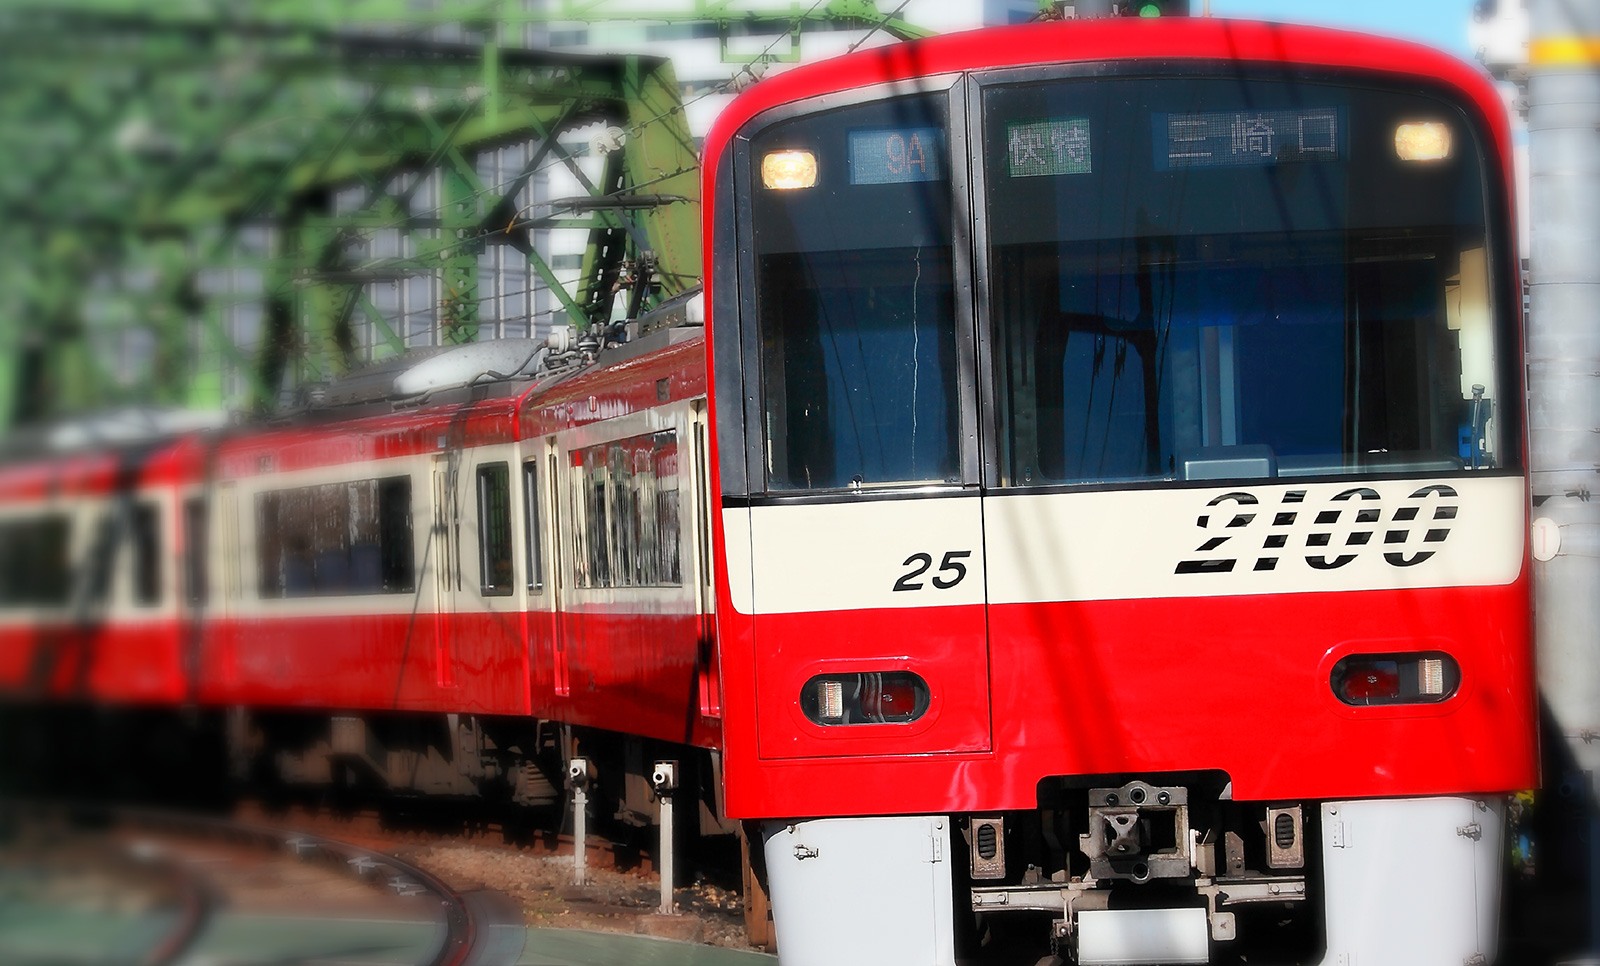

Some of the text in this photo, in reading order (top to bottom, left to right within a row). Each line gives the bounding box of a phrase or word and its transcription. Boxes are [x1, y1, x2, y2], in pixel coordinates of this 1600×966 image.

[886, 133, 926, 174] 9A
[1008, 124, 1087, 166] 快特
[1168, 113, 1336, 157] 三崎口
[1173, 484, 1459, 574] 2100
[892, 550, 972, 592] 25
